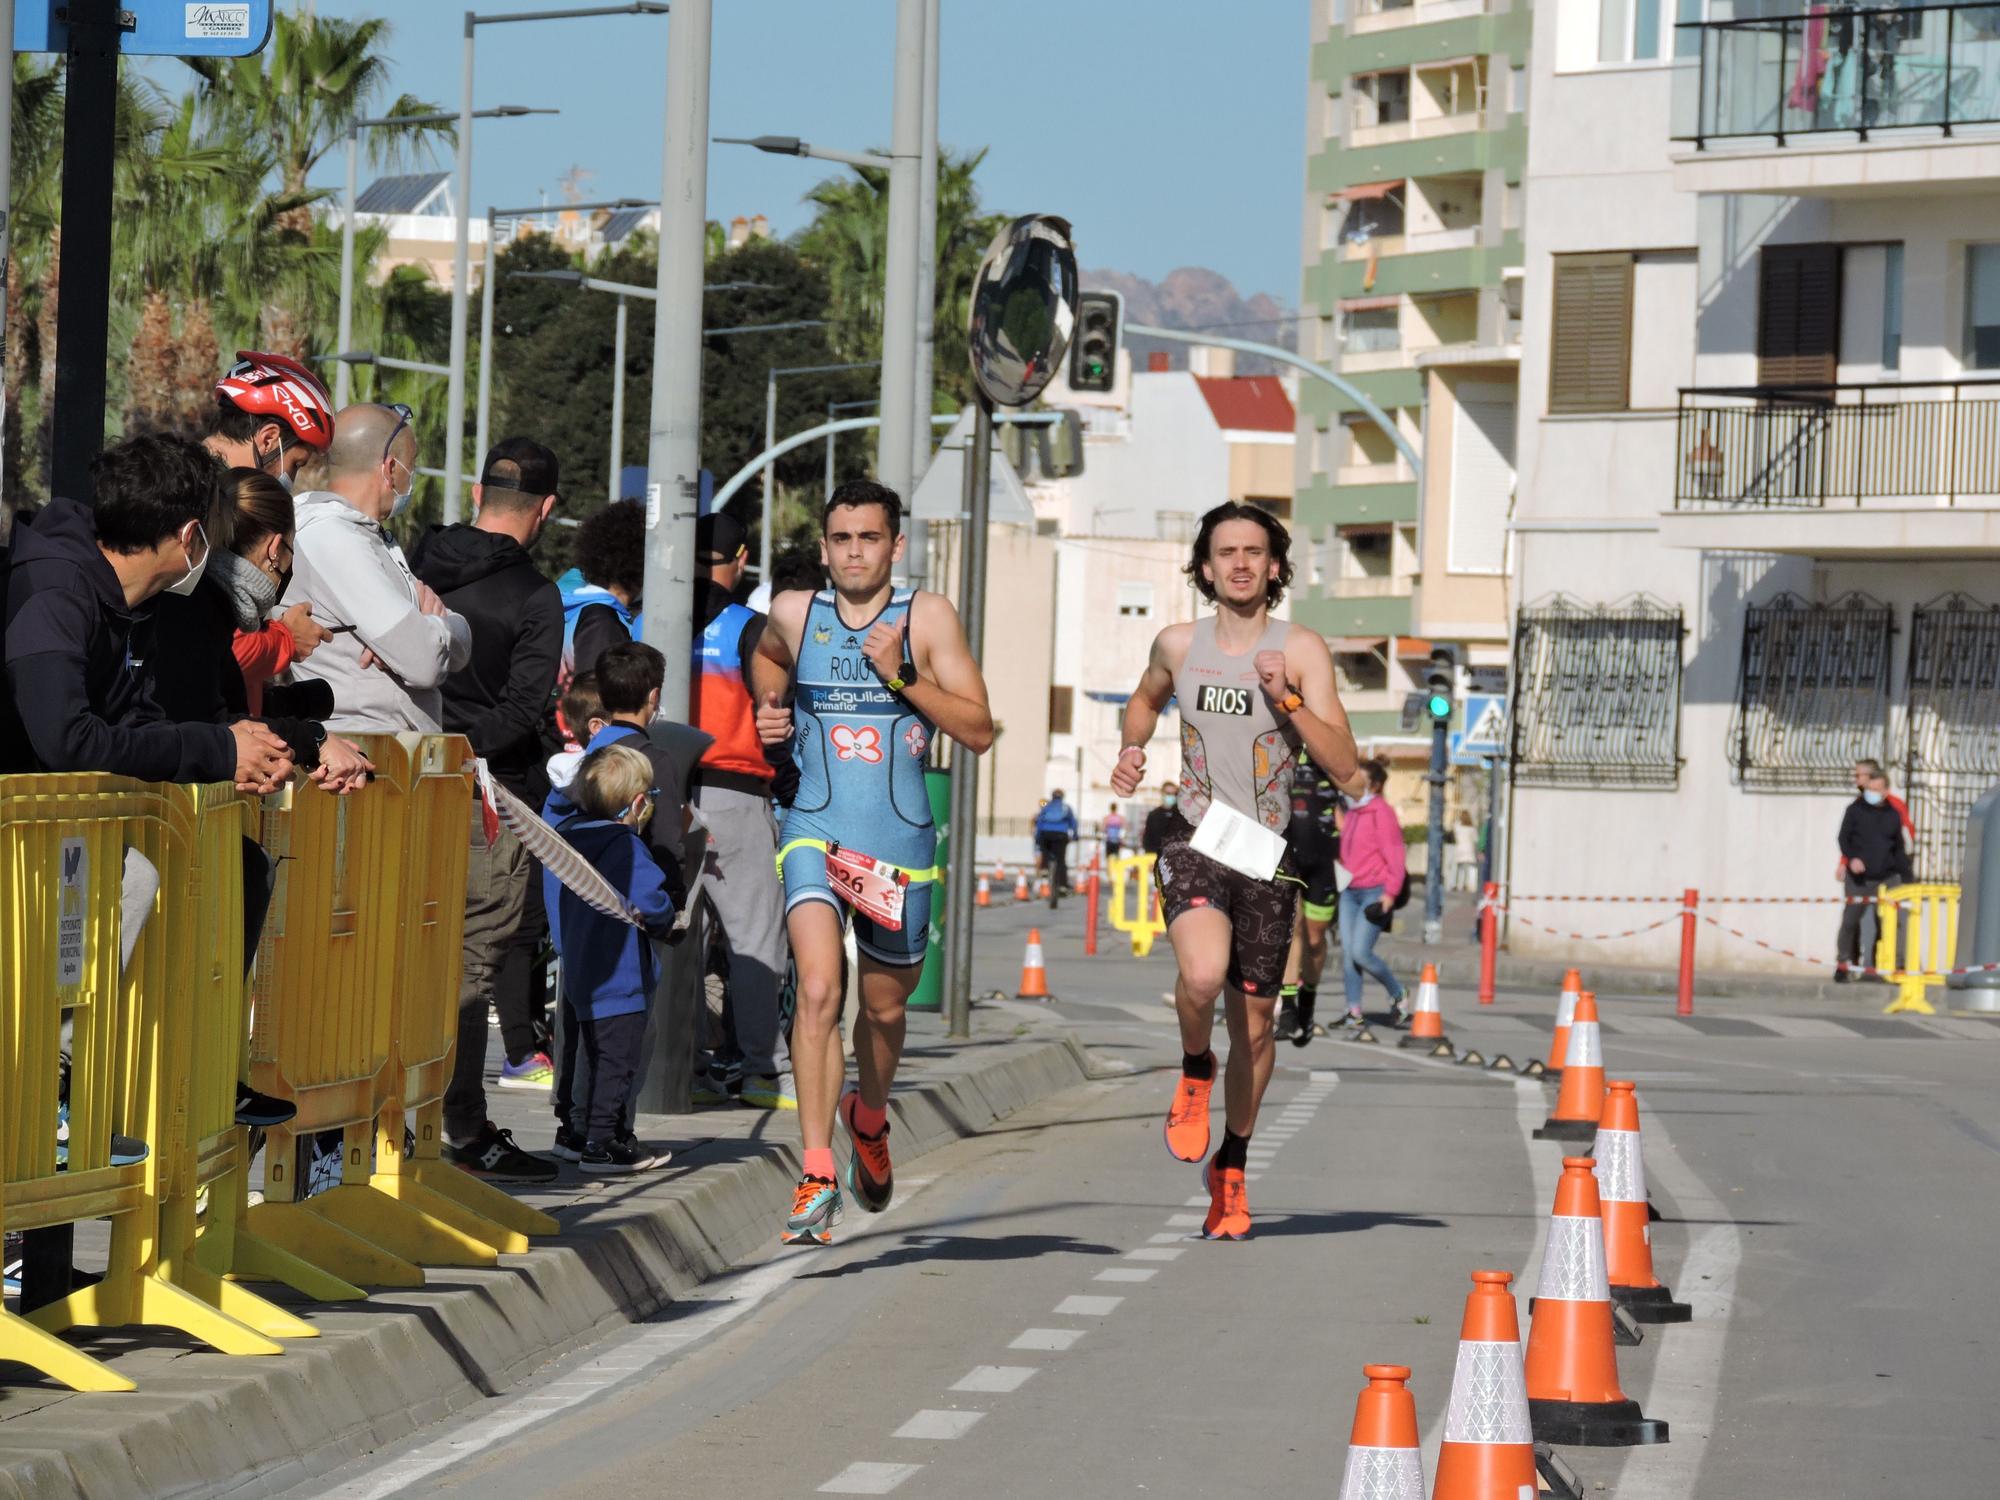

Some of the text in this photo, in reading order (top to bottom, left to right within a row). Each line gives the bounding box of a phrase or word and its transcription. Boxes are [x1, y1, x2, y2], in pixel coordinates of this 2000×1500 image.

[830, 656, 869, 681] ROJO
[813, 701, 858, 712] Primaflor
[1203, 686, 1248, 715] RIOS
